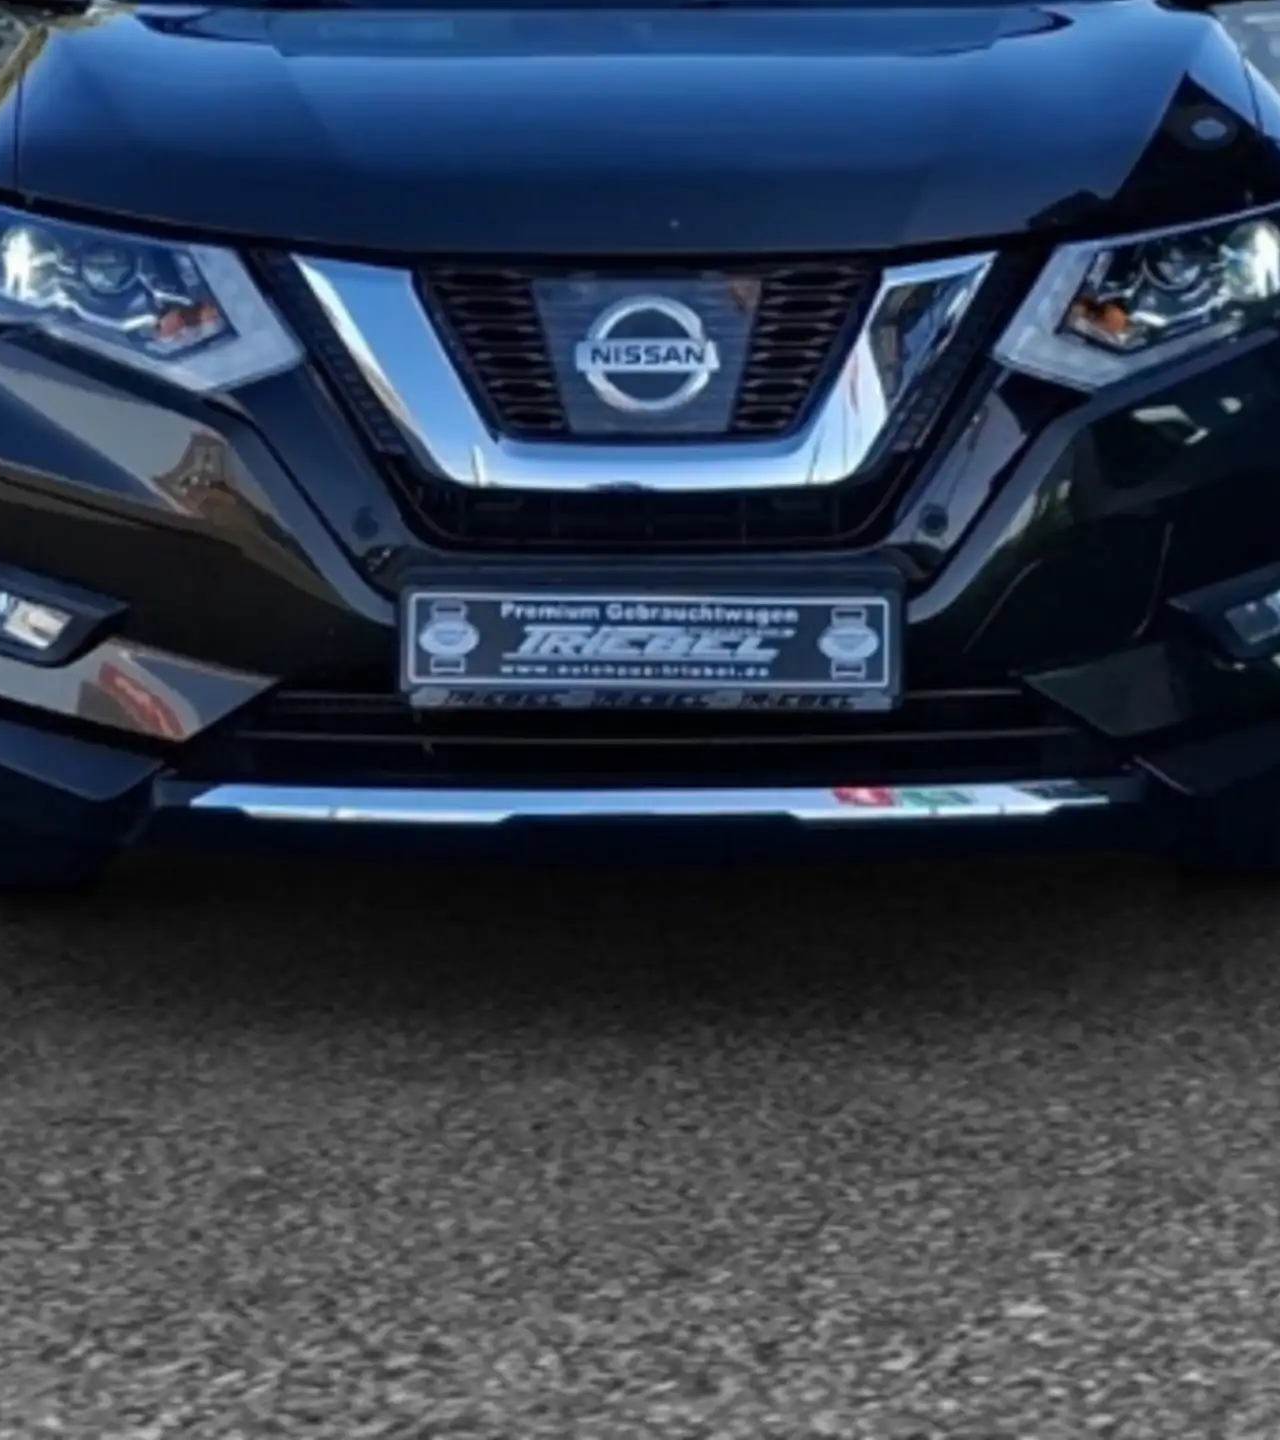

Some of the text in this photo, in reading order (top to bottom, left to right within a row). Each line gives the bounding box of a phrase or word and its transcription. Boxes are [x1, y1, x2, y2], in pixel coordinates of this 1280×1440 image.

[589, 344, 705, 367] NISSAN
[500, 601, 800, 627] Premium Gebrauchtwagen
